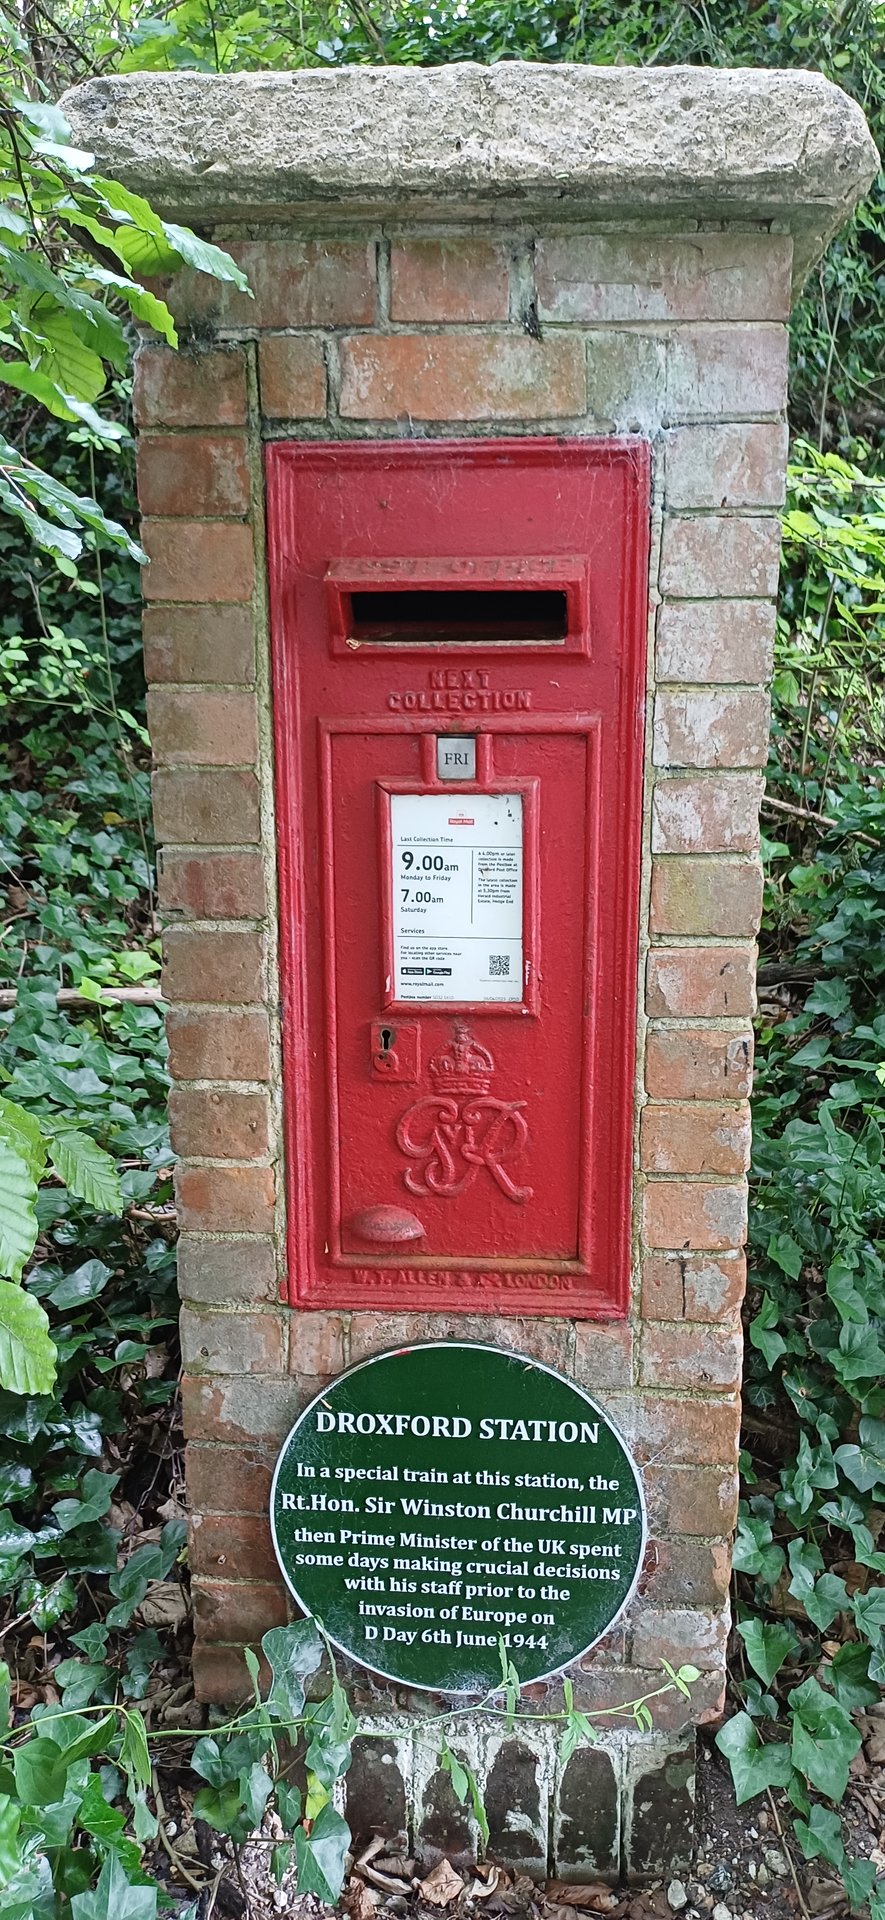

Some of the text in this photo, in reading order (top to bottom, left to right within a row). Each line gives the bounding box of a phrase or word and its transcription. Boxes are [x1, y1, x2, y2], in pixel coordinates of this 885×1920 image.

[430, 669, 491, 688] NEXT
[388, 689, 532, 711] COLLECTION
[444, 752, 469, 765] FRI
[401, 851, 459, 871] 9.00am
[400, 874, 424, 882] Monday
[400, 888, 444, 903] 7.00am
[400, 906, 427, 914] Saturday
[399, 1270, 451, 1289] ALLEN
[503, 1273, 575, 1291] LONDON
[316, 1411, 600, 1444] DROXFORD STATION
[296, 1462, 620, 1492] In a special train at this station, the
[281, 1493, 637, 1526] Rt.Hon. Sir Winston Churchill MP
[294, 1527, 623, 1560] then Prime Minister of the UK spent
[295, 1552, 621, 1581] some days making crucial decisions
[343, 1576, 571, 1601] with his staff prior to the
[358, 1600, 556, 1627] invasion of Europe on
[364, 1625, 549, 1650] D Day 6th June 1944
